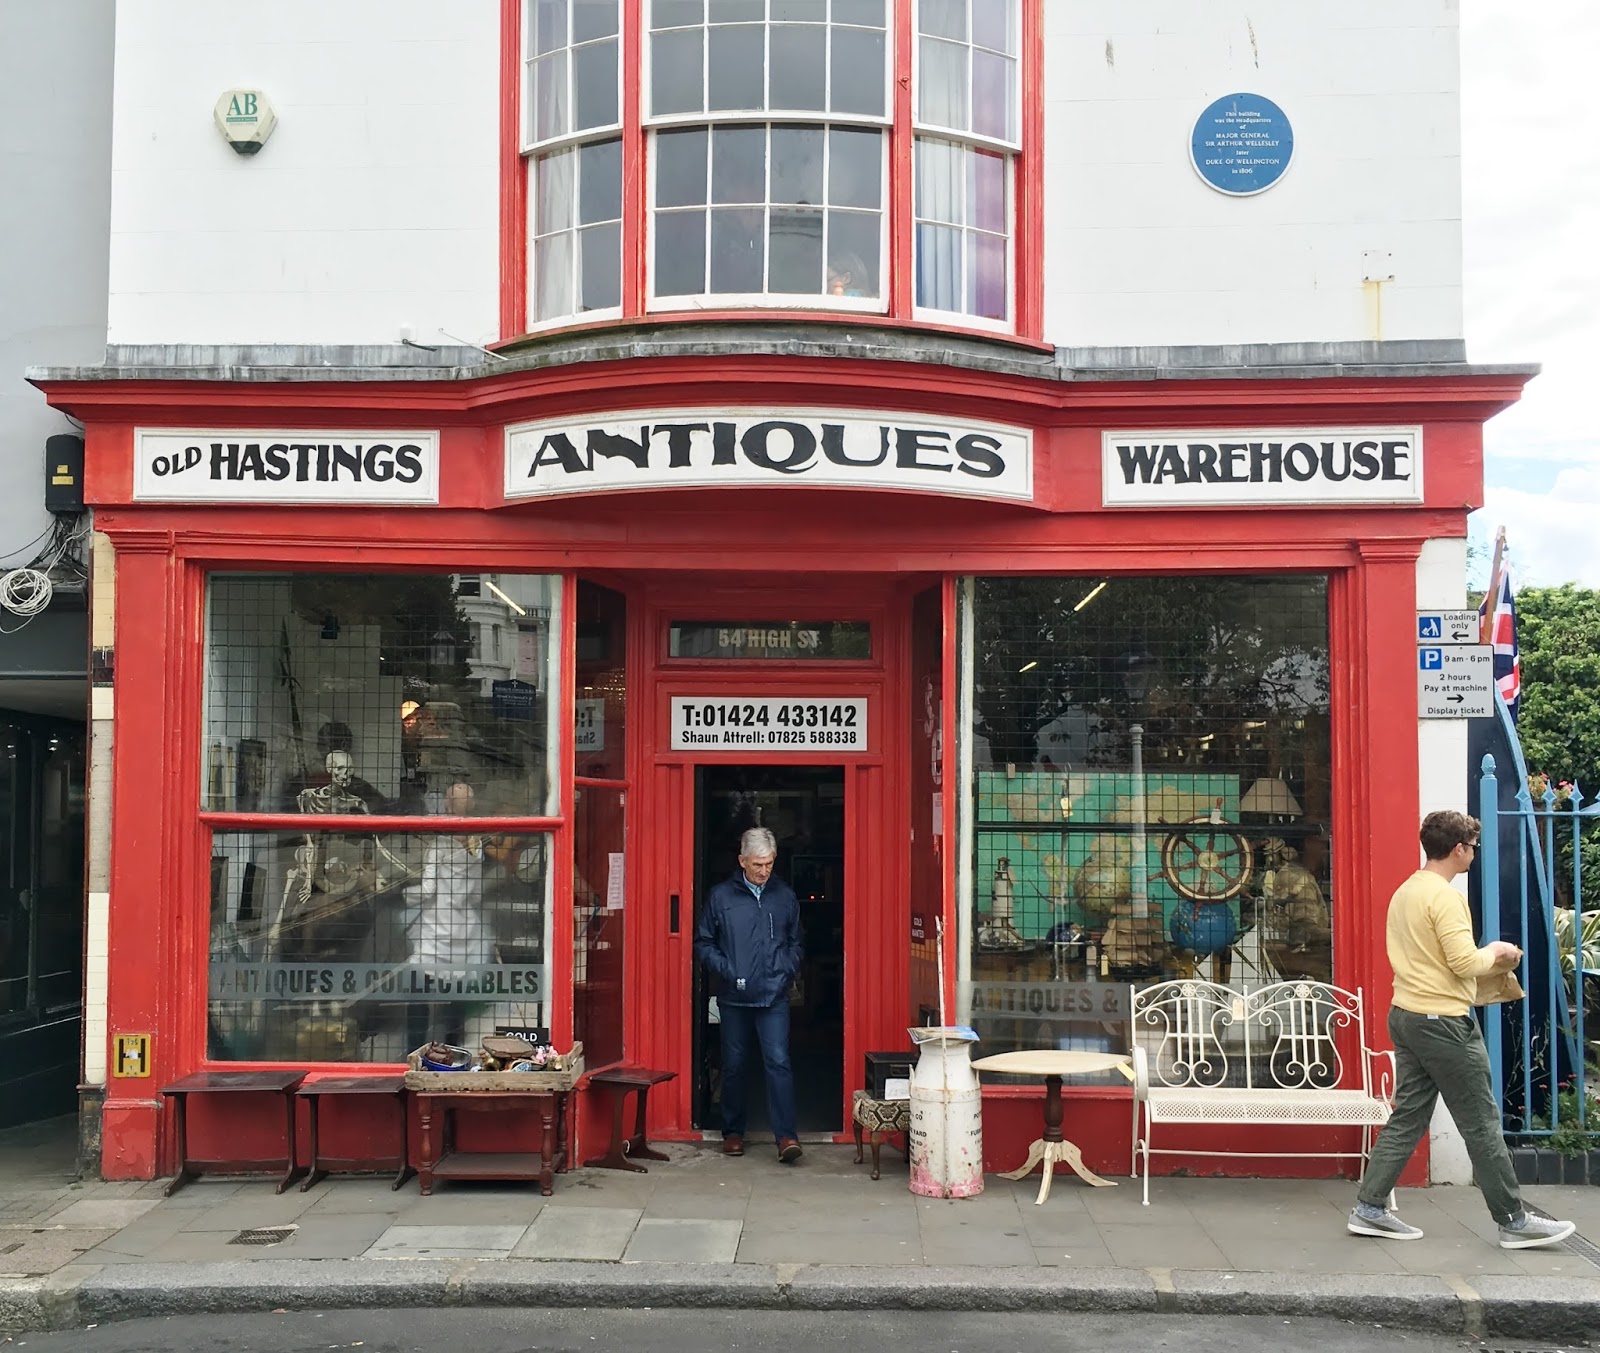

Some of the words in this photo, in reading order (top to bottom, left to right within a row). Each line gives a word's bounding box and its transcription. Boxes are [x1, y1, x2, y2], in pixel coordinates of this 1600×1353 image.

[227, 93, 258, 116] AB
[527, 420, 1007, 478] ANTIQUES
[151, 446, 203, 477] OLD
[209, 443, 424, 484] HASTINGS
[1115, 440, 1411, 484] WAREHOUSE
[1443, 614, 1477, 622] Loading
[1451, 622, 1469, 630] only
[718, 628, 742, 648] 54
[747, 629, 791, 648] HIGH
[1424, 650, 1439, 669] P
[1424, 685, 1439, 693] Pay
[1452, 684, 1488, 692] machine
[682, 705, 769, 727] T:01424
[777, 705, 857, 727] 433142
[1427, 707, 1458, 715] Display
[682, 730, 718, 744] Shaun
[723, 731, 765, 744] Attrell:
[768, 731, 806, 744] 07825
[809, 731, 857, 744] 588338
[342, 970, 357, 994] &
[365, 969, 539, 995] COLLECTABLES
[971, 988, 1094, 1016] ANTIQUES
[1102, 989, 1119, 1013] &
